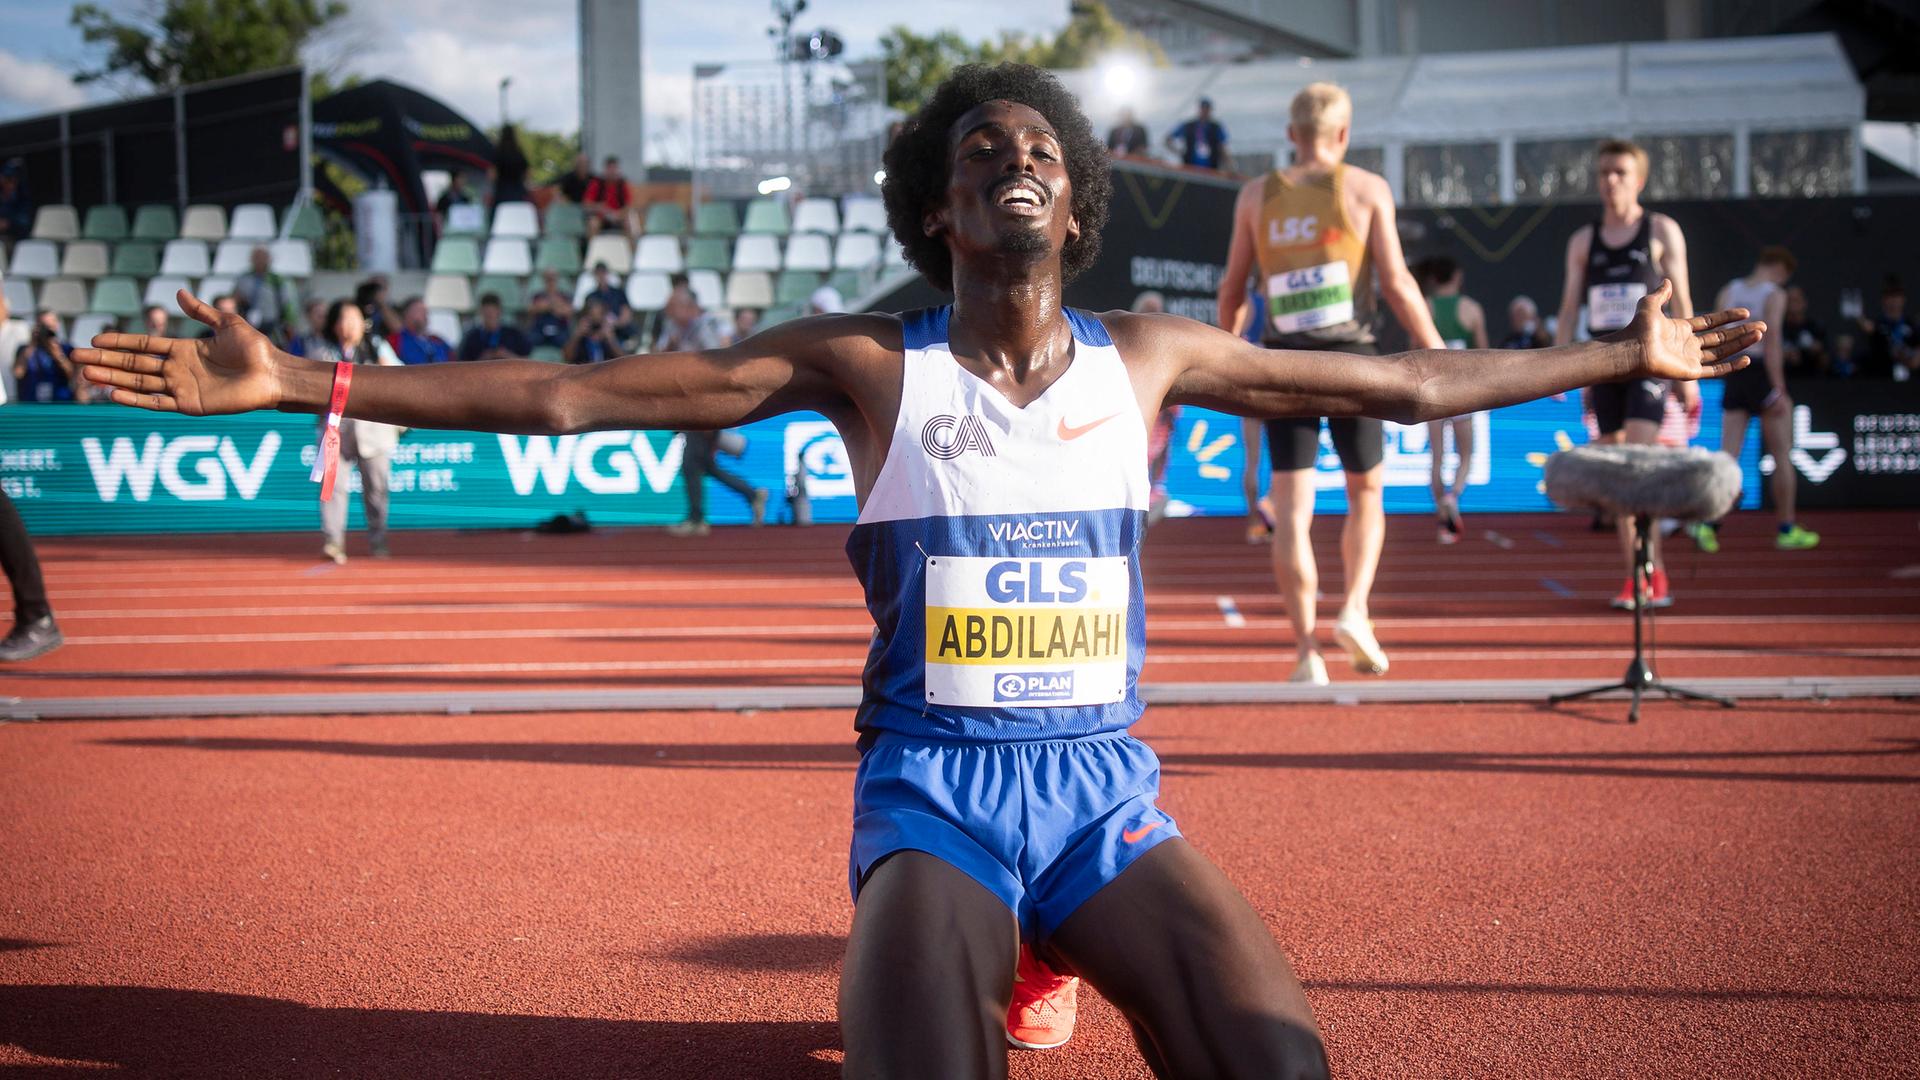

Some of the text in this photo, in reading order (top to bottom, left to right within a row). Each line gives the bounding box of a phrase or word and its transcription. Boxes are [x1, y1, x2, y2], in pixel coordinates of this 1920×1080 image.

[1269, 216, 1317, 244] LSC
[1130, 256, 1217, 291] DEUTSCHE
[921, 414, 997, 461] CA
[81, 431, 282, 502] WGV
[497, 431, 687, 495] WGV
[1853, 455, 1920, 474] VERBA
[988, 519, 1079, 542] VIACTIV
[938, 613, 1121, 659] ABDILAAHI
[1028, 676, 1072, 691] PLAN
